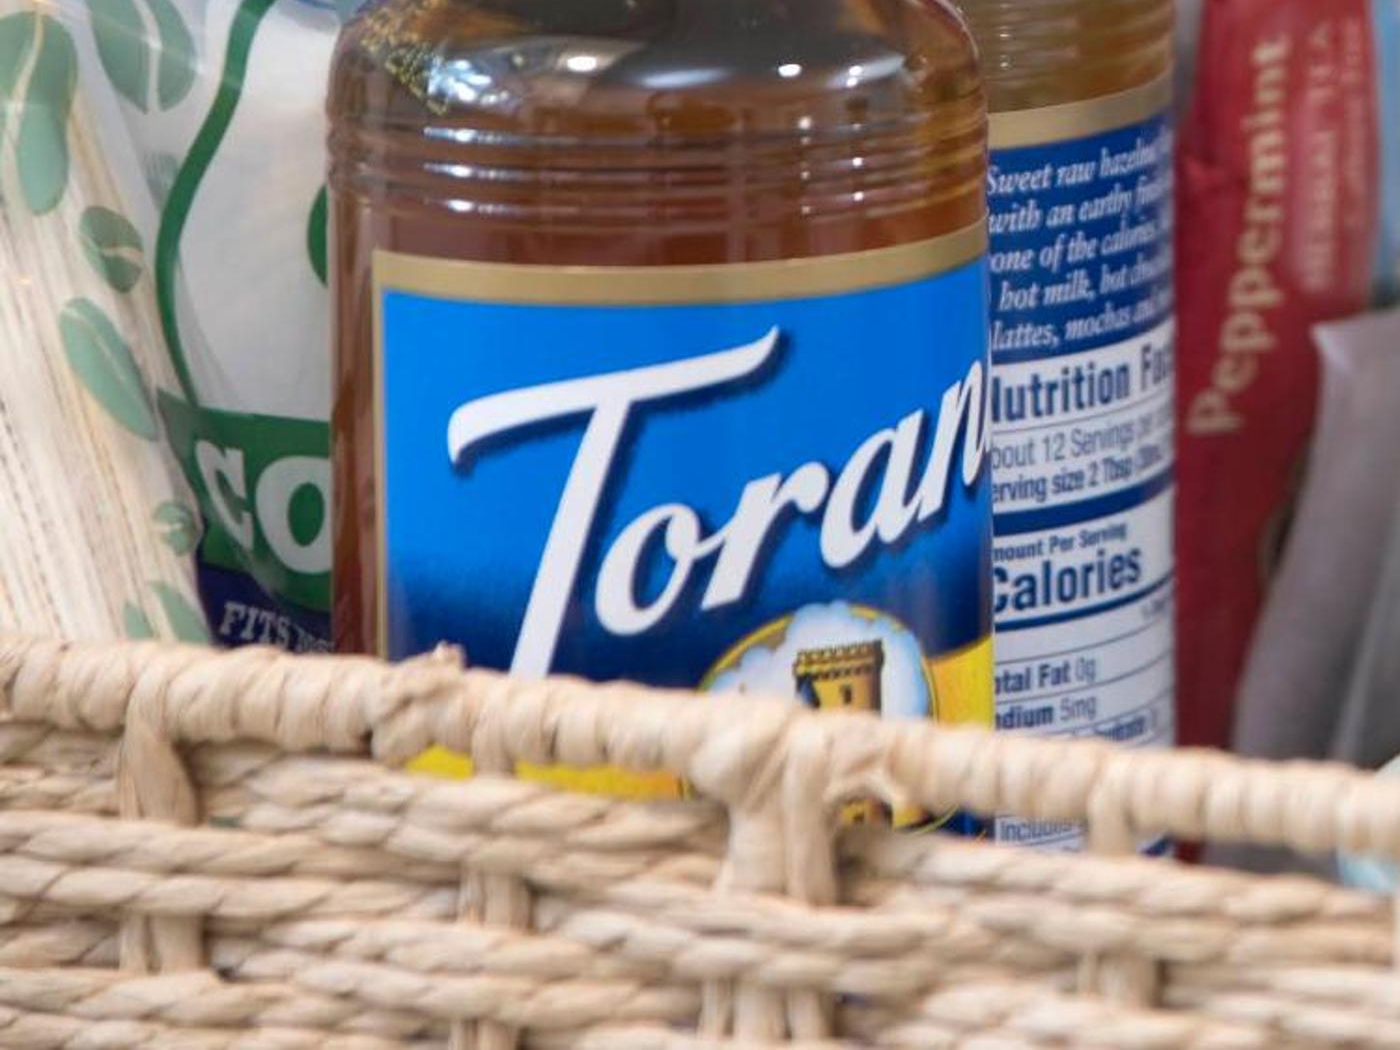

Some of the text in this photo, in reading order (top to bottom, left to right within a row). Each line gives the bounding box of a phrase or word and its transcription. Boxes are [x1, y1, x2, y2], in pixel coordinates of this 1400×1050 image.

[987, 162, 1051, 195] Sweet
[1054, 159, 1097, 189] raw
[988, 197, 1042, 233] with
[1046, 203, 1074, 228] an
[1187, 33, 1291, 434] Peppermint
[989, 248, 1035, 275] one
[1039, 233, 1067, 273] of
[1067, 230, 1099, 263] the
[999, 280, 1041, 312] hot
[1041, 432, 1066, 463] 12
[1050, 468, 1086, 495] size
[1088, 461, 1099, 488] 2
[1049, 532, 1075, 554] Per
[993, 548, 1142, 614] Calories
[994, 657, 1097, 695] tal Fat 0g
[995, 696, 1097, 730] dium 5mg
